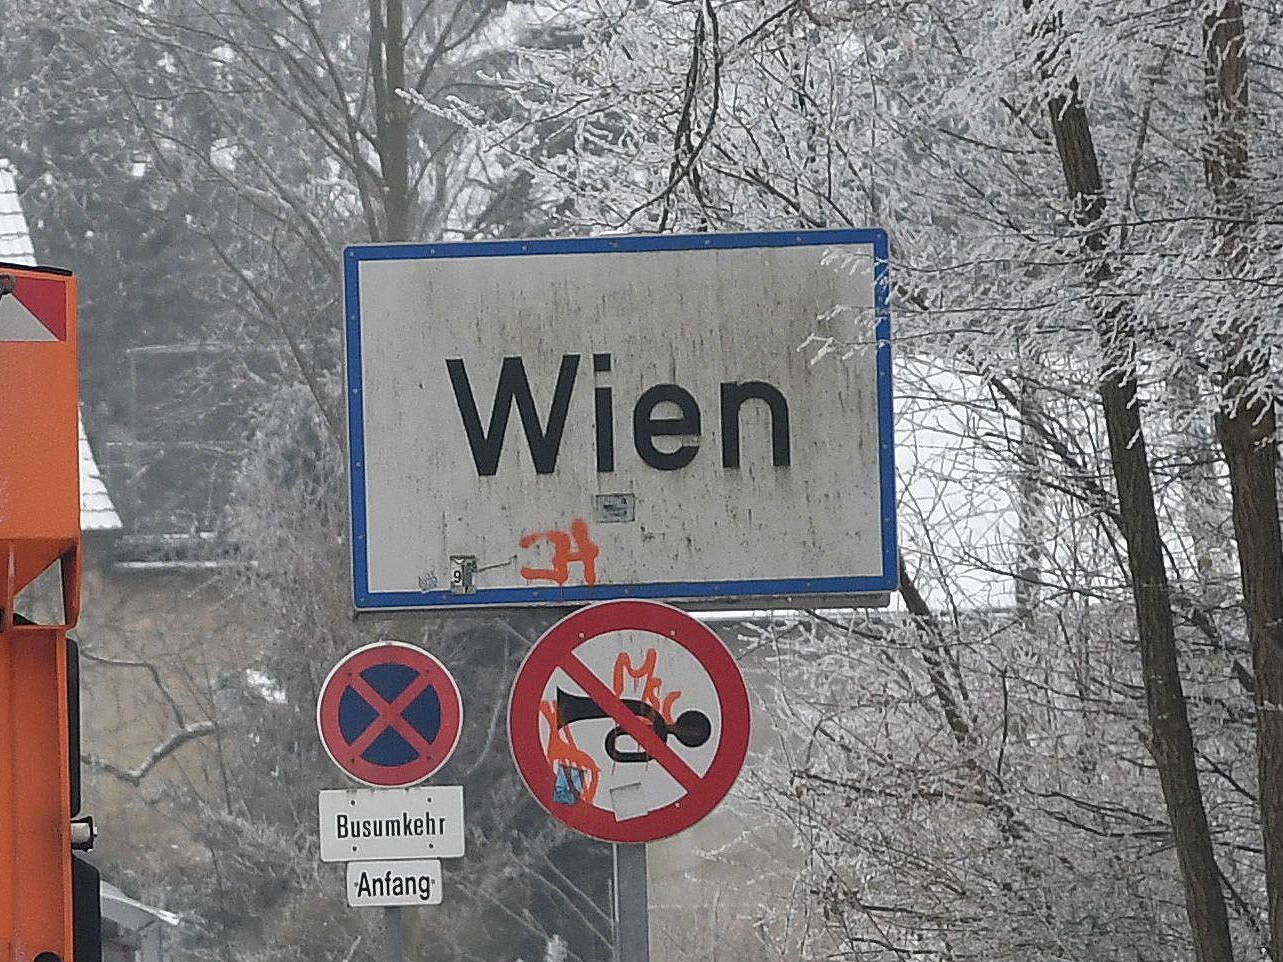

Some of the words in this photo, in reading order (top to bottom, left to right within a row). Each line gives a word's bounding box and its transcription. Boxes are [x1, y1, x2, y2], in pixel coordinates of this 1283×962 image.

[445, 353, 791, 476] Wien
[336, 811, 446, 839] Busumkehr
[357, 870, 431, 901] Anfang
